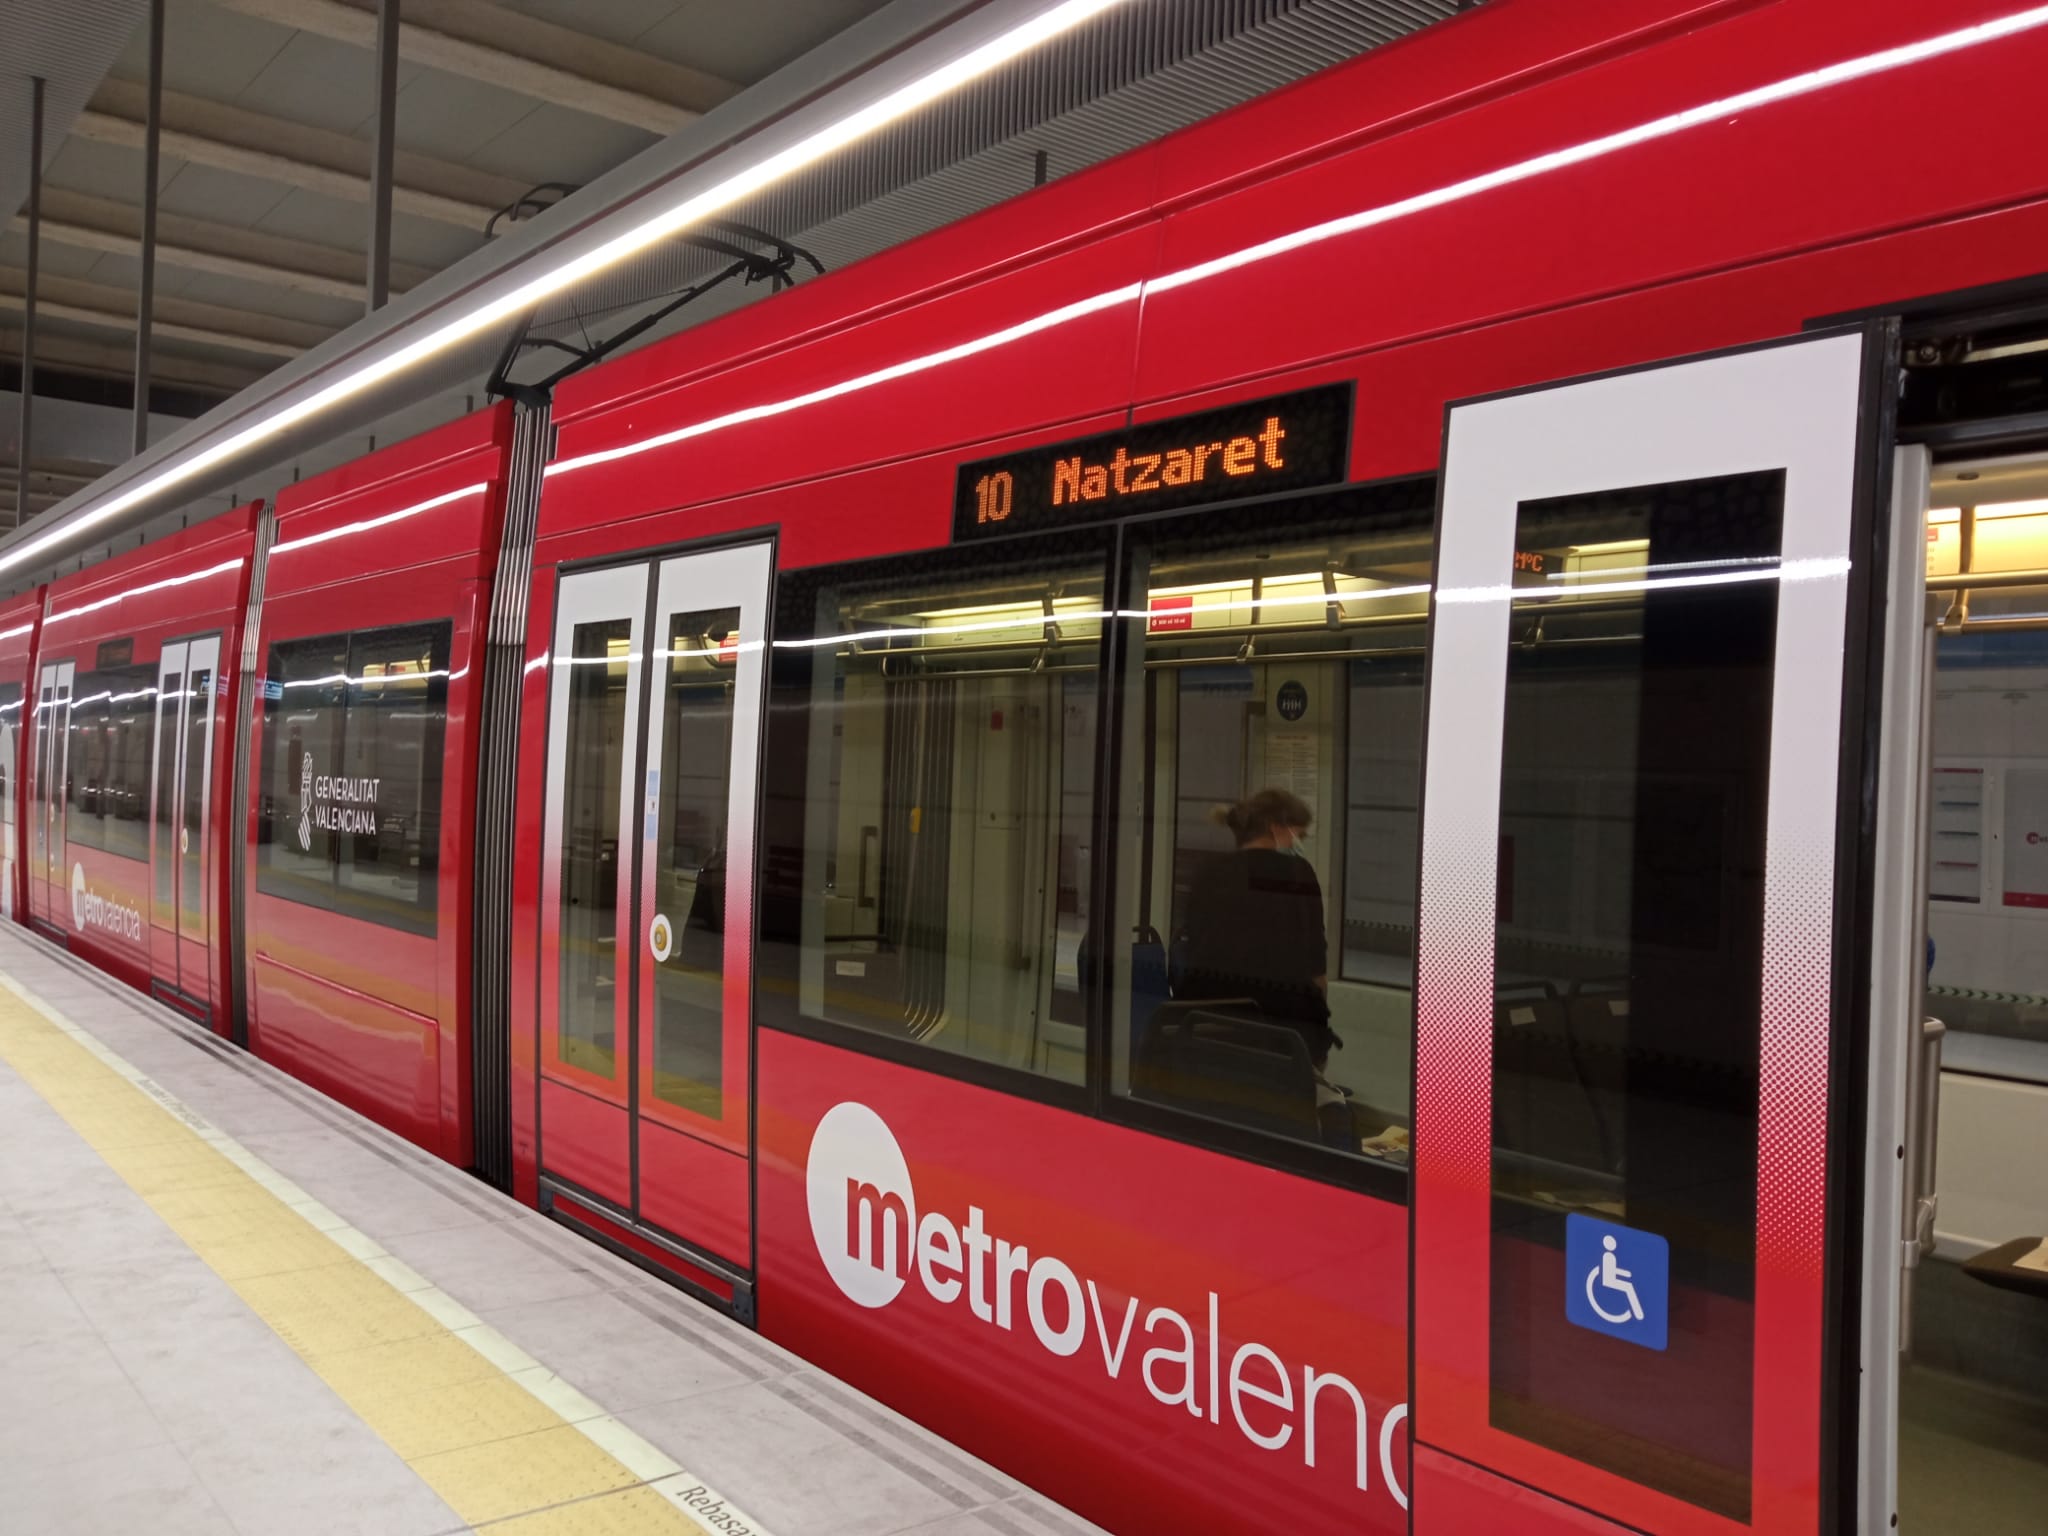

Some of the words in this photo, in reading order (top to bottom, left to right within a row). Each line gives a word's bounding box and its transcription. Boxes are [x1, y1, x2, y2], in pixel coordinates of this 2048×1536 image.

[975, 471, 1013, 524] 10
[1053, 416, 1285, 505] Natzaret
[315, 775, 380, 803] GENERALITAT
[315, 805, 377, 835] VALENCIANA
[676, 1486, 756, 1536] Rebasa
